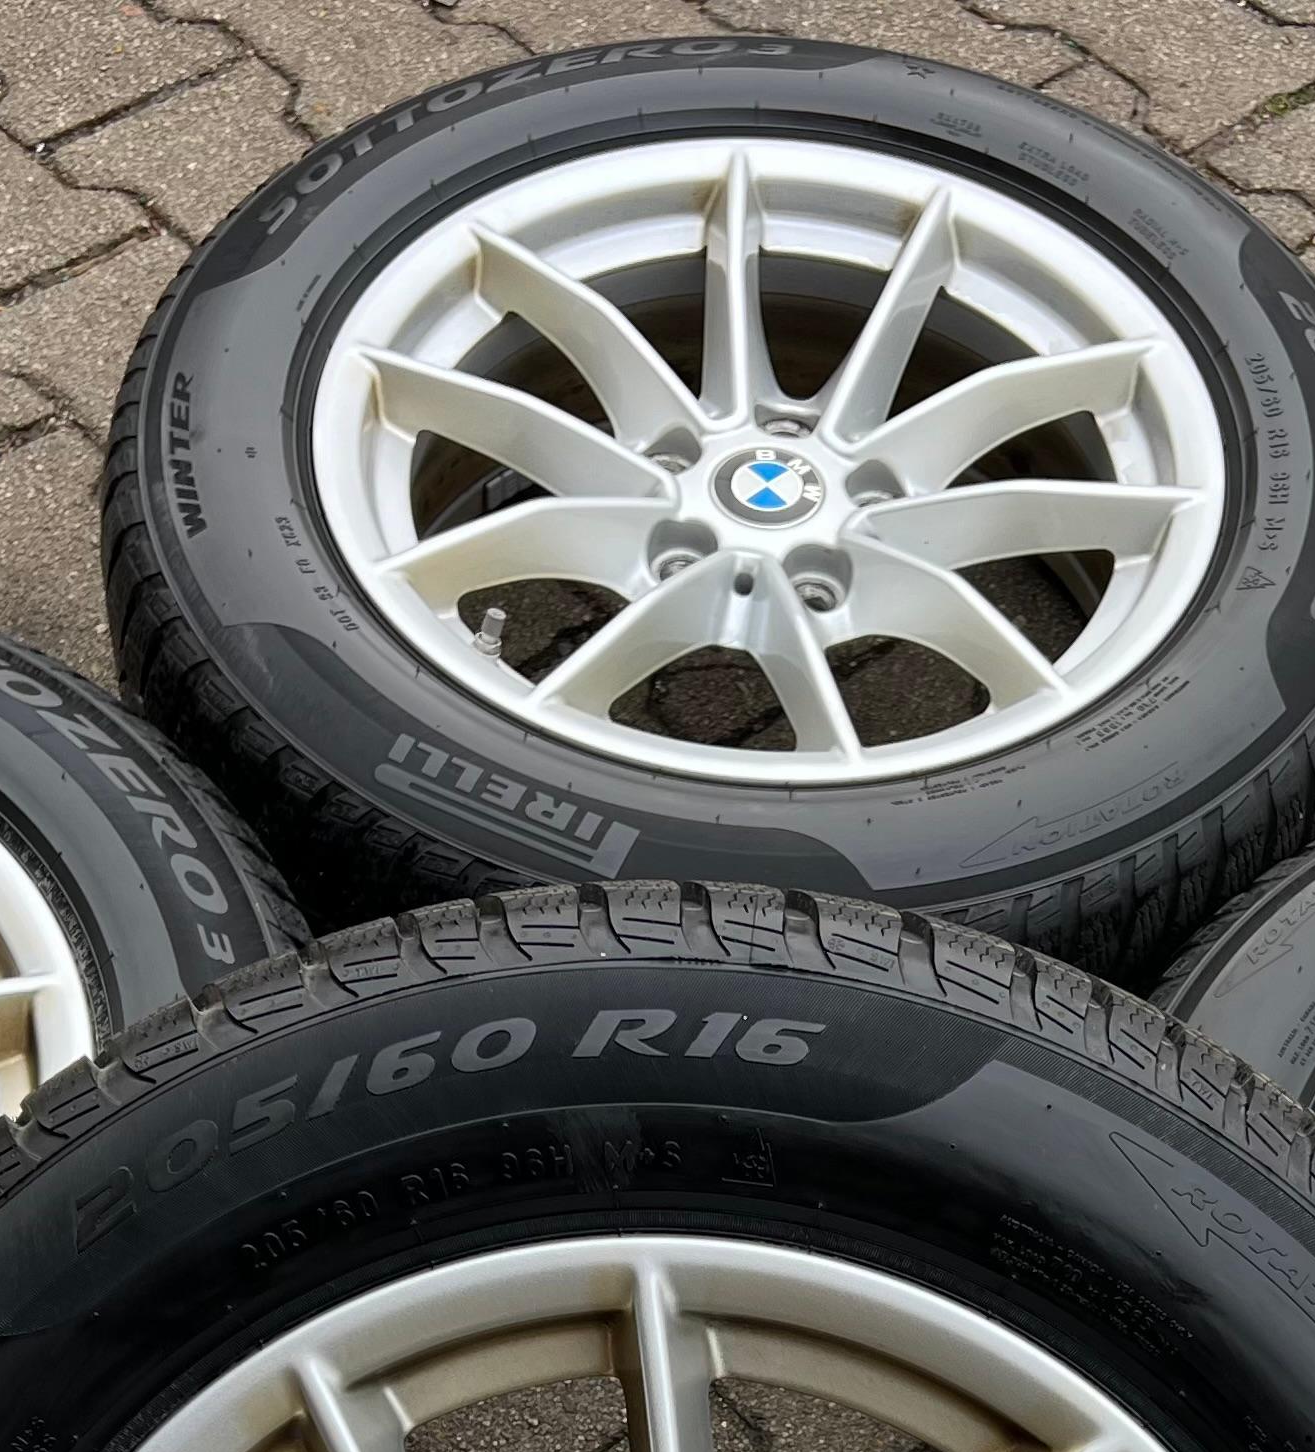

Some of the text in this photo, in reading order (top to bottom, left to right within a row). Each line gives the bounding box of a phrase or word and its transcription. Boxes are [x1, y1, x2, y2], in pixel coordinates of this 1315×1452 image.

[257, 39, 792, 234] SOTTOZERO 3
[161, 372, 211, 539] WINTER
[754, 449, 822, 502] BMW
[375, 733, 640, 878] PIRELLI
[197, 923, 235, 966] 3
[75, 1009, 827, 1256] 205/60 R16
